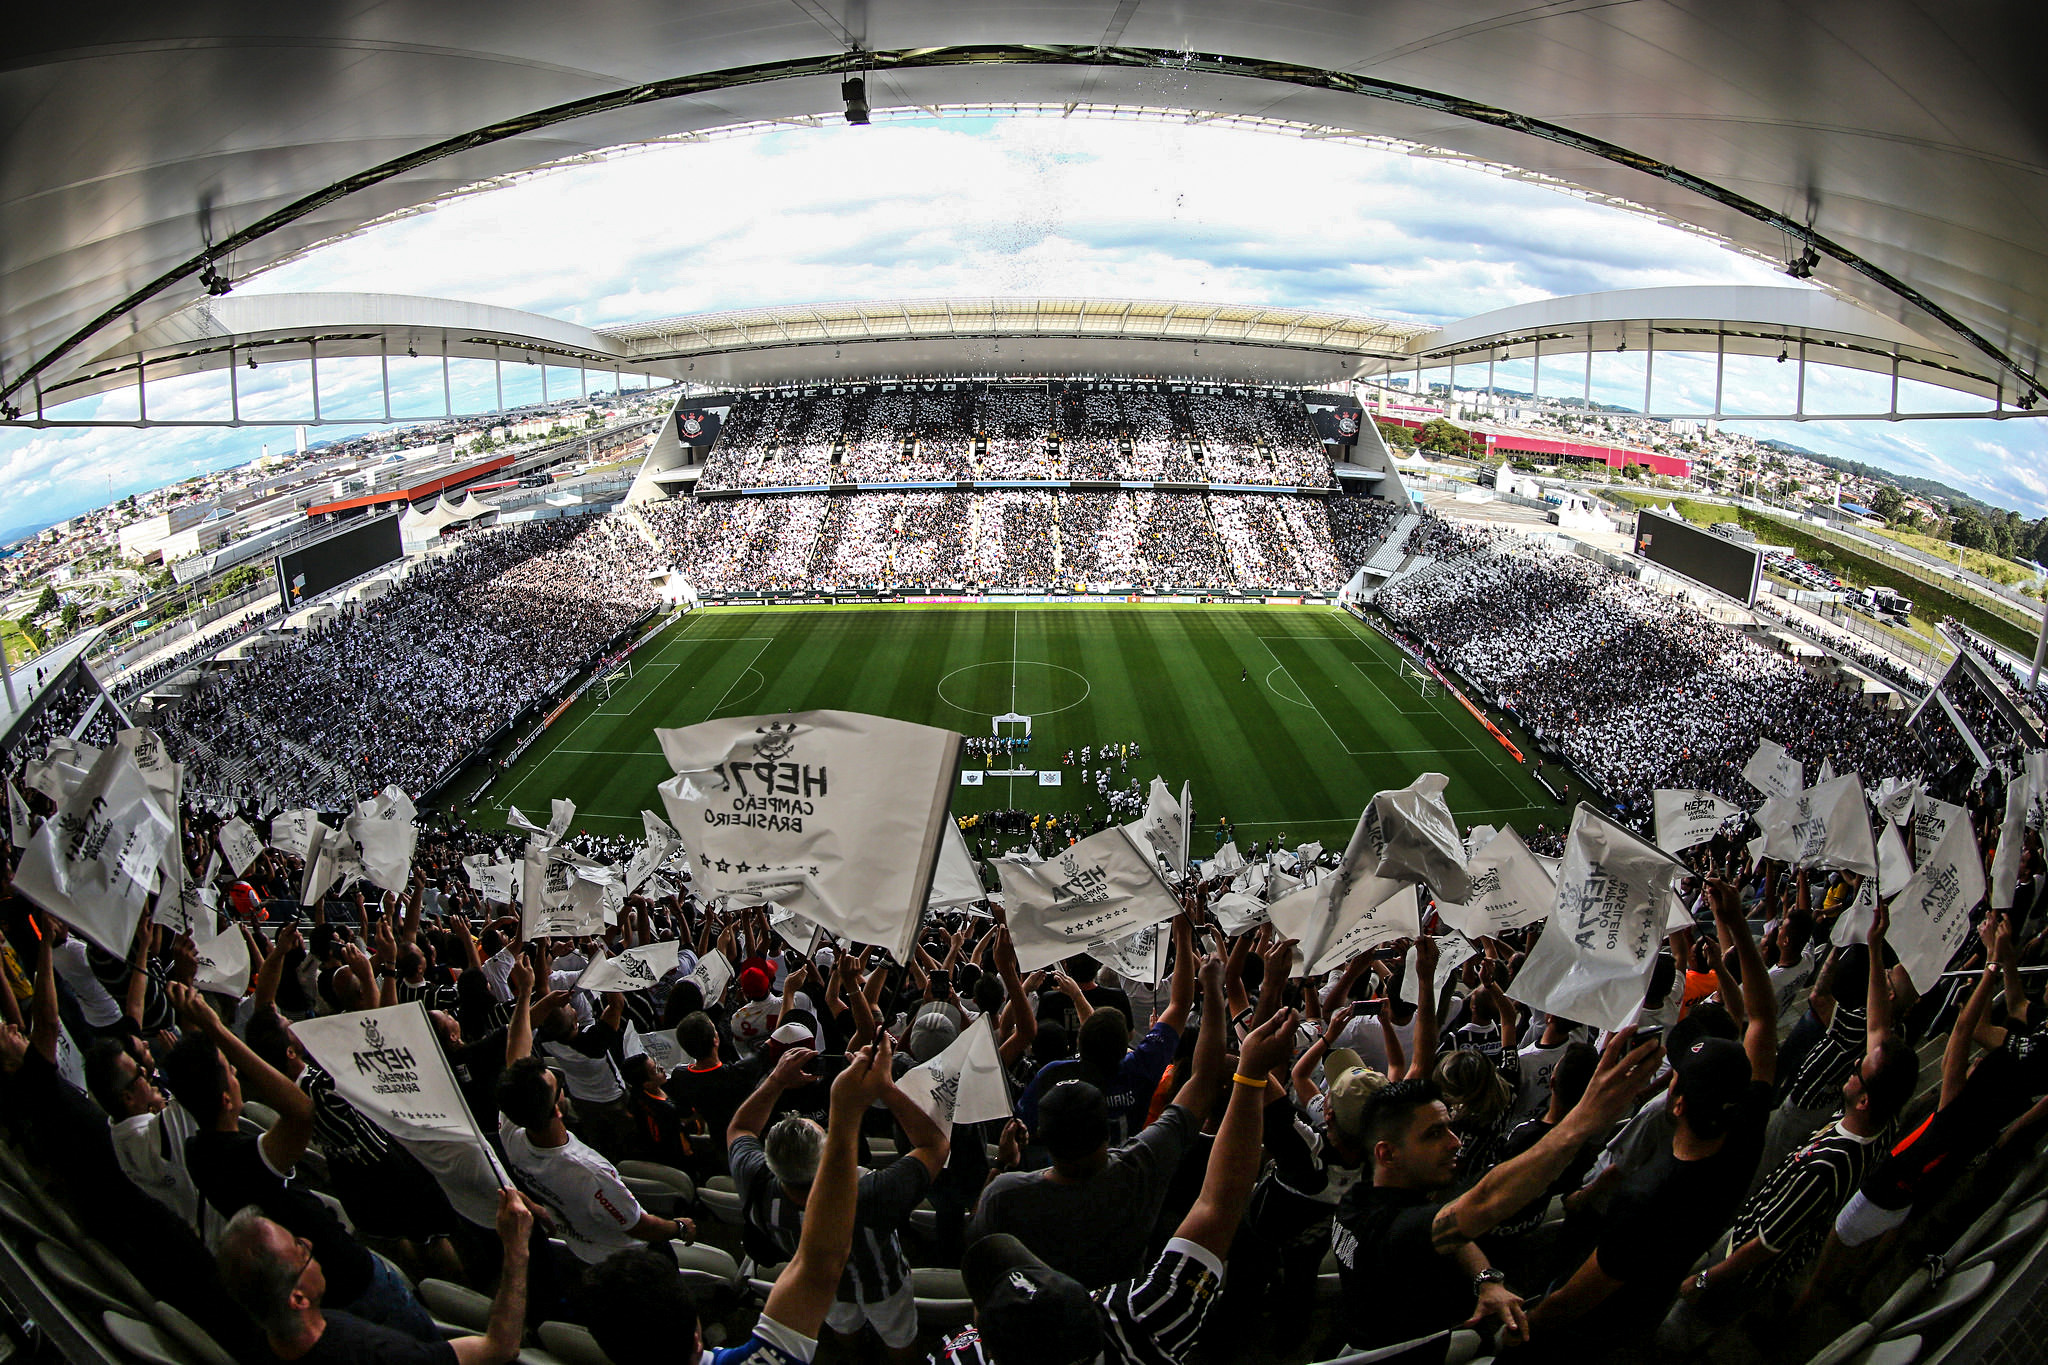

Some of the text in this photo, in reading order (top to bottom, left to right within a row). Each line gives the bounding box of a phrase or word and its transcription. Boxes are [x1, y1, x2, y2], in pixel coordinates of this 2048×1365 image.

[750, 383, 957, 400] TIME DO POVO
[1172, 385, 1223, 396] POR
